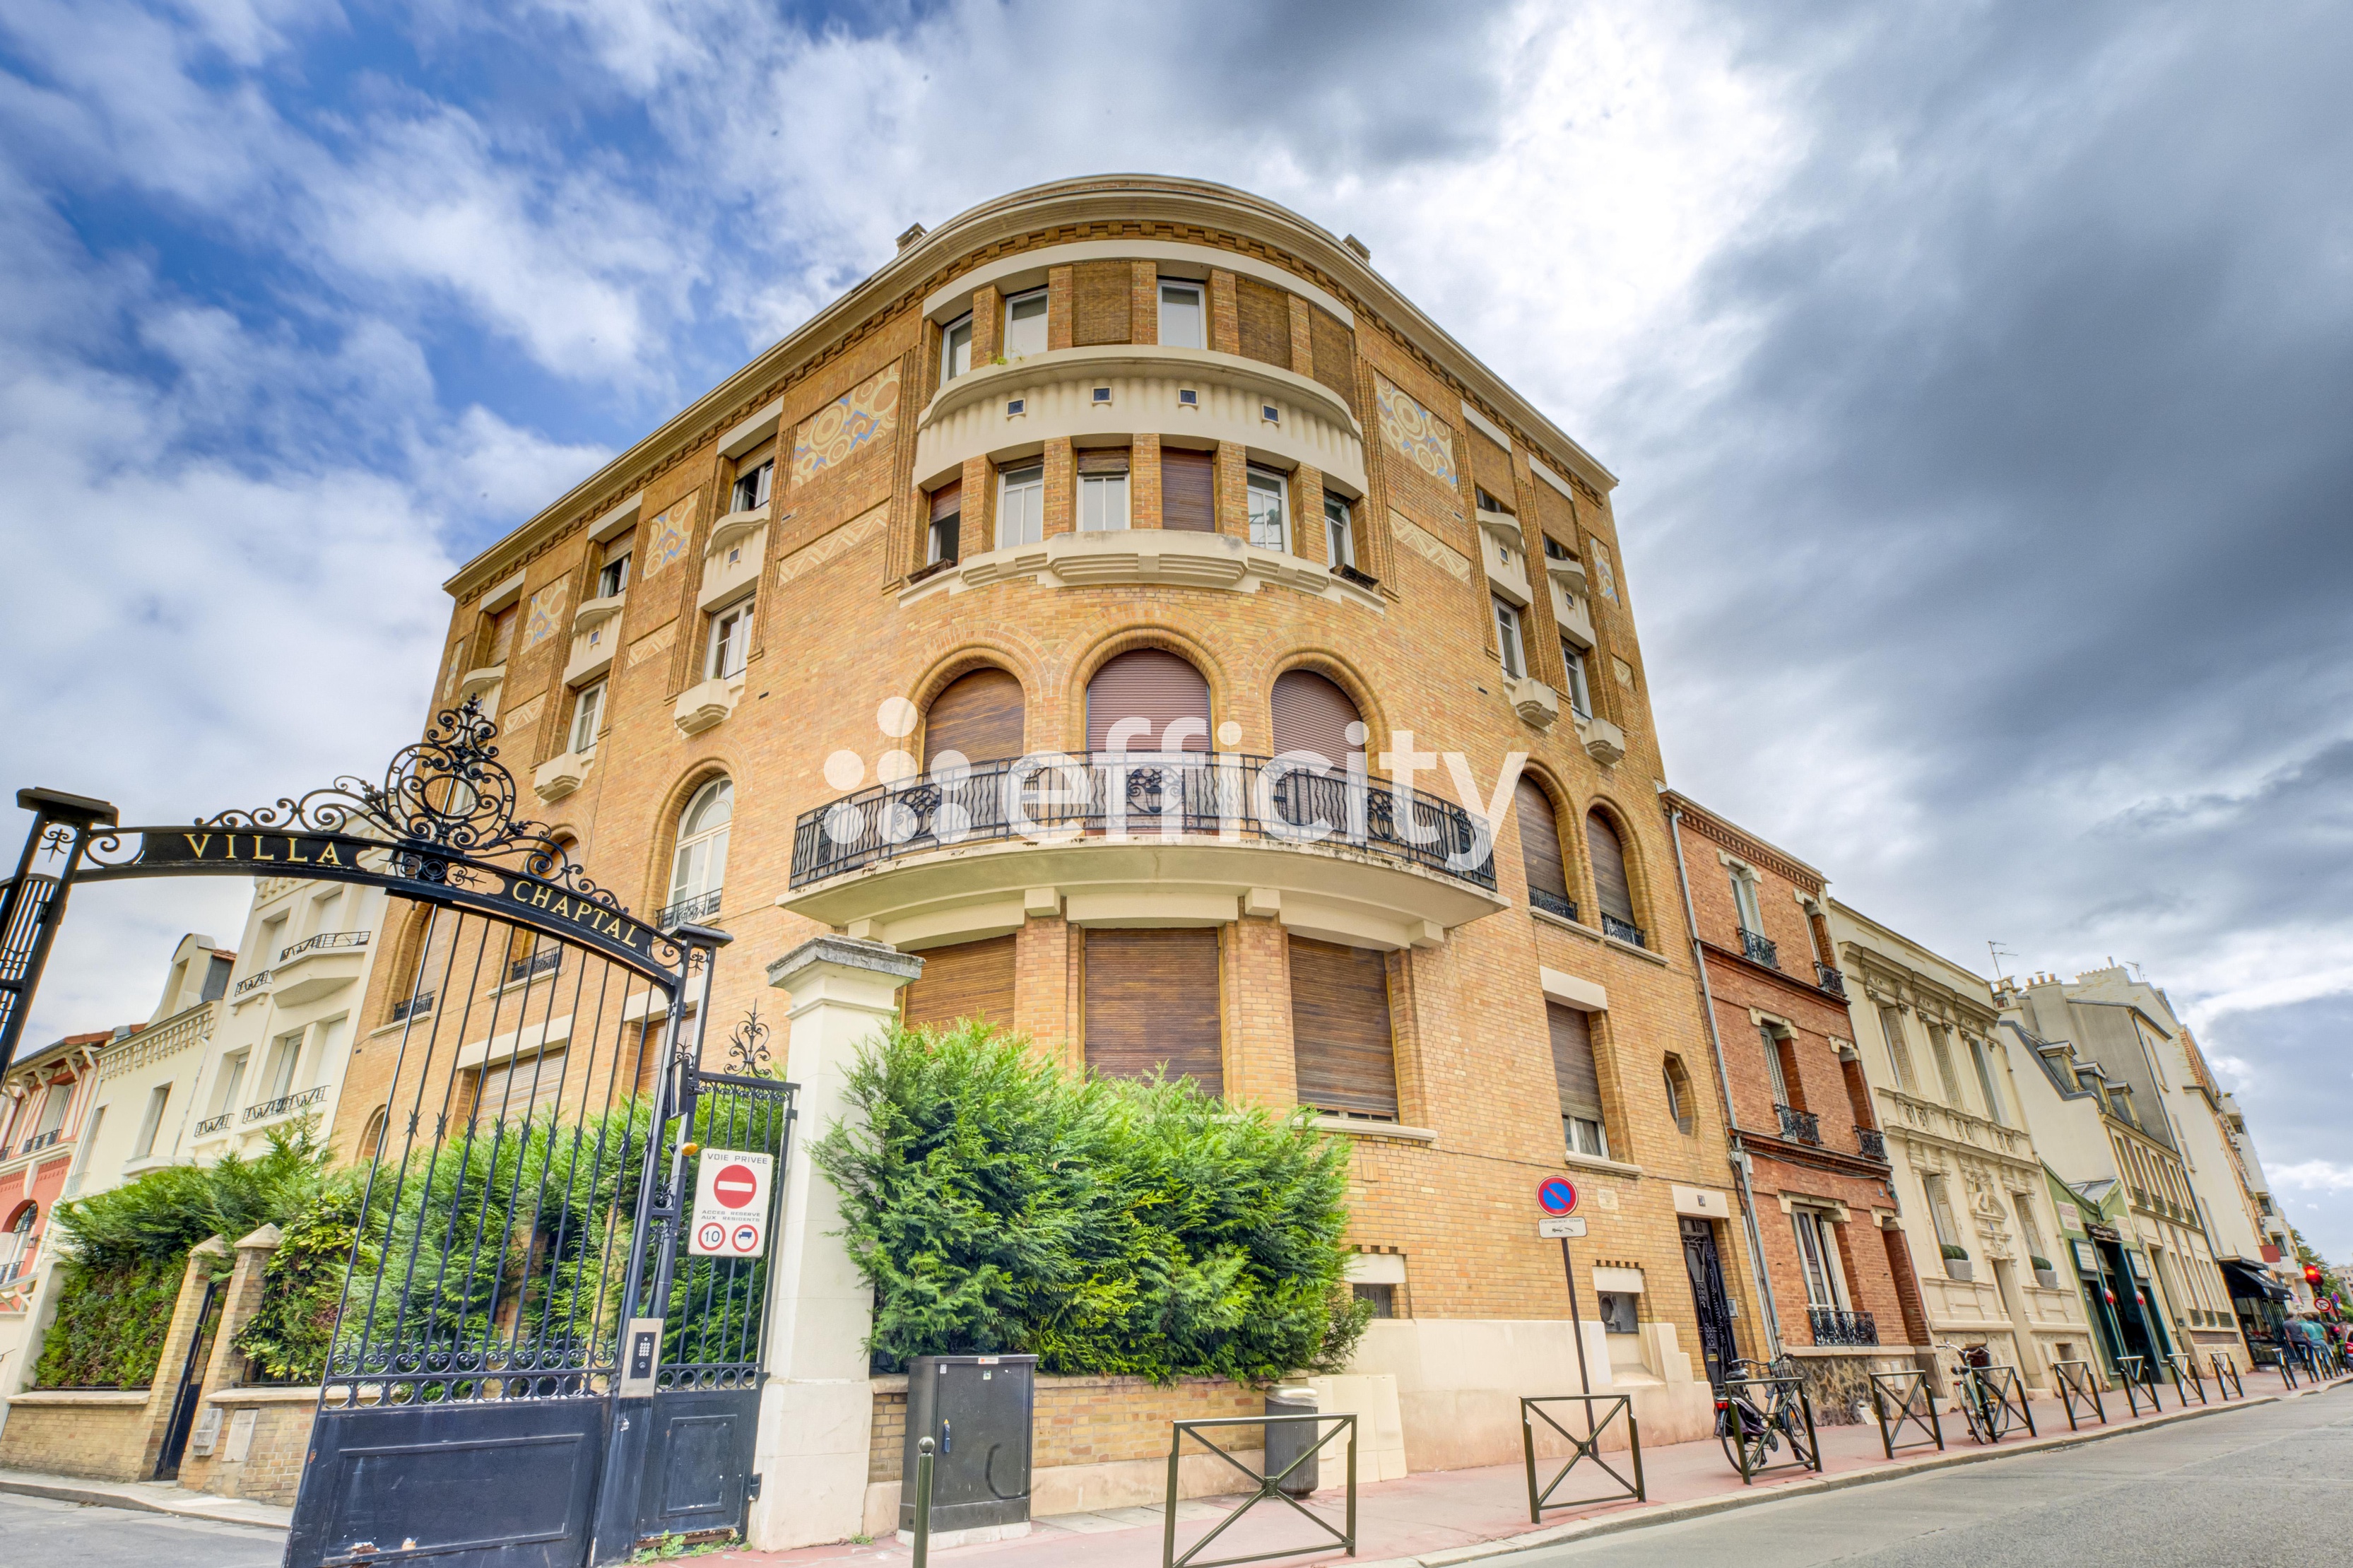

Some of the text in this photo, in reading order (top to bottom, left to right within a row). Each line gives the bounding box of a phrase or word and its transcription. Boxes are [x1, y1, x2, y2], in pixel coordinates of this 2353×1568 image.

[183, 833, 637, 948] VILLA CHAPTAL
[734, 1155, 767, 1165] PRIVEE
[705, 1230, 720, 1242] 10
